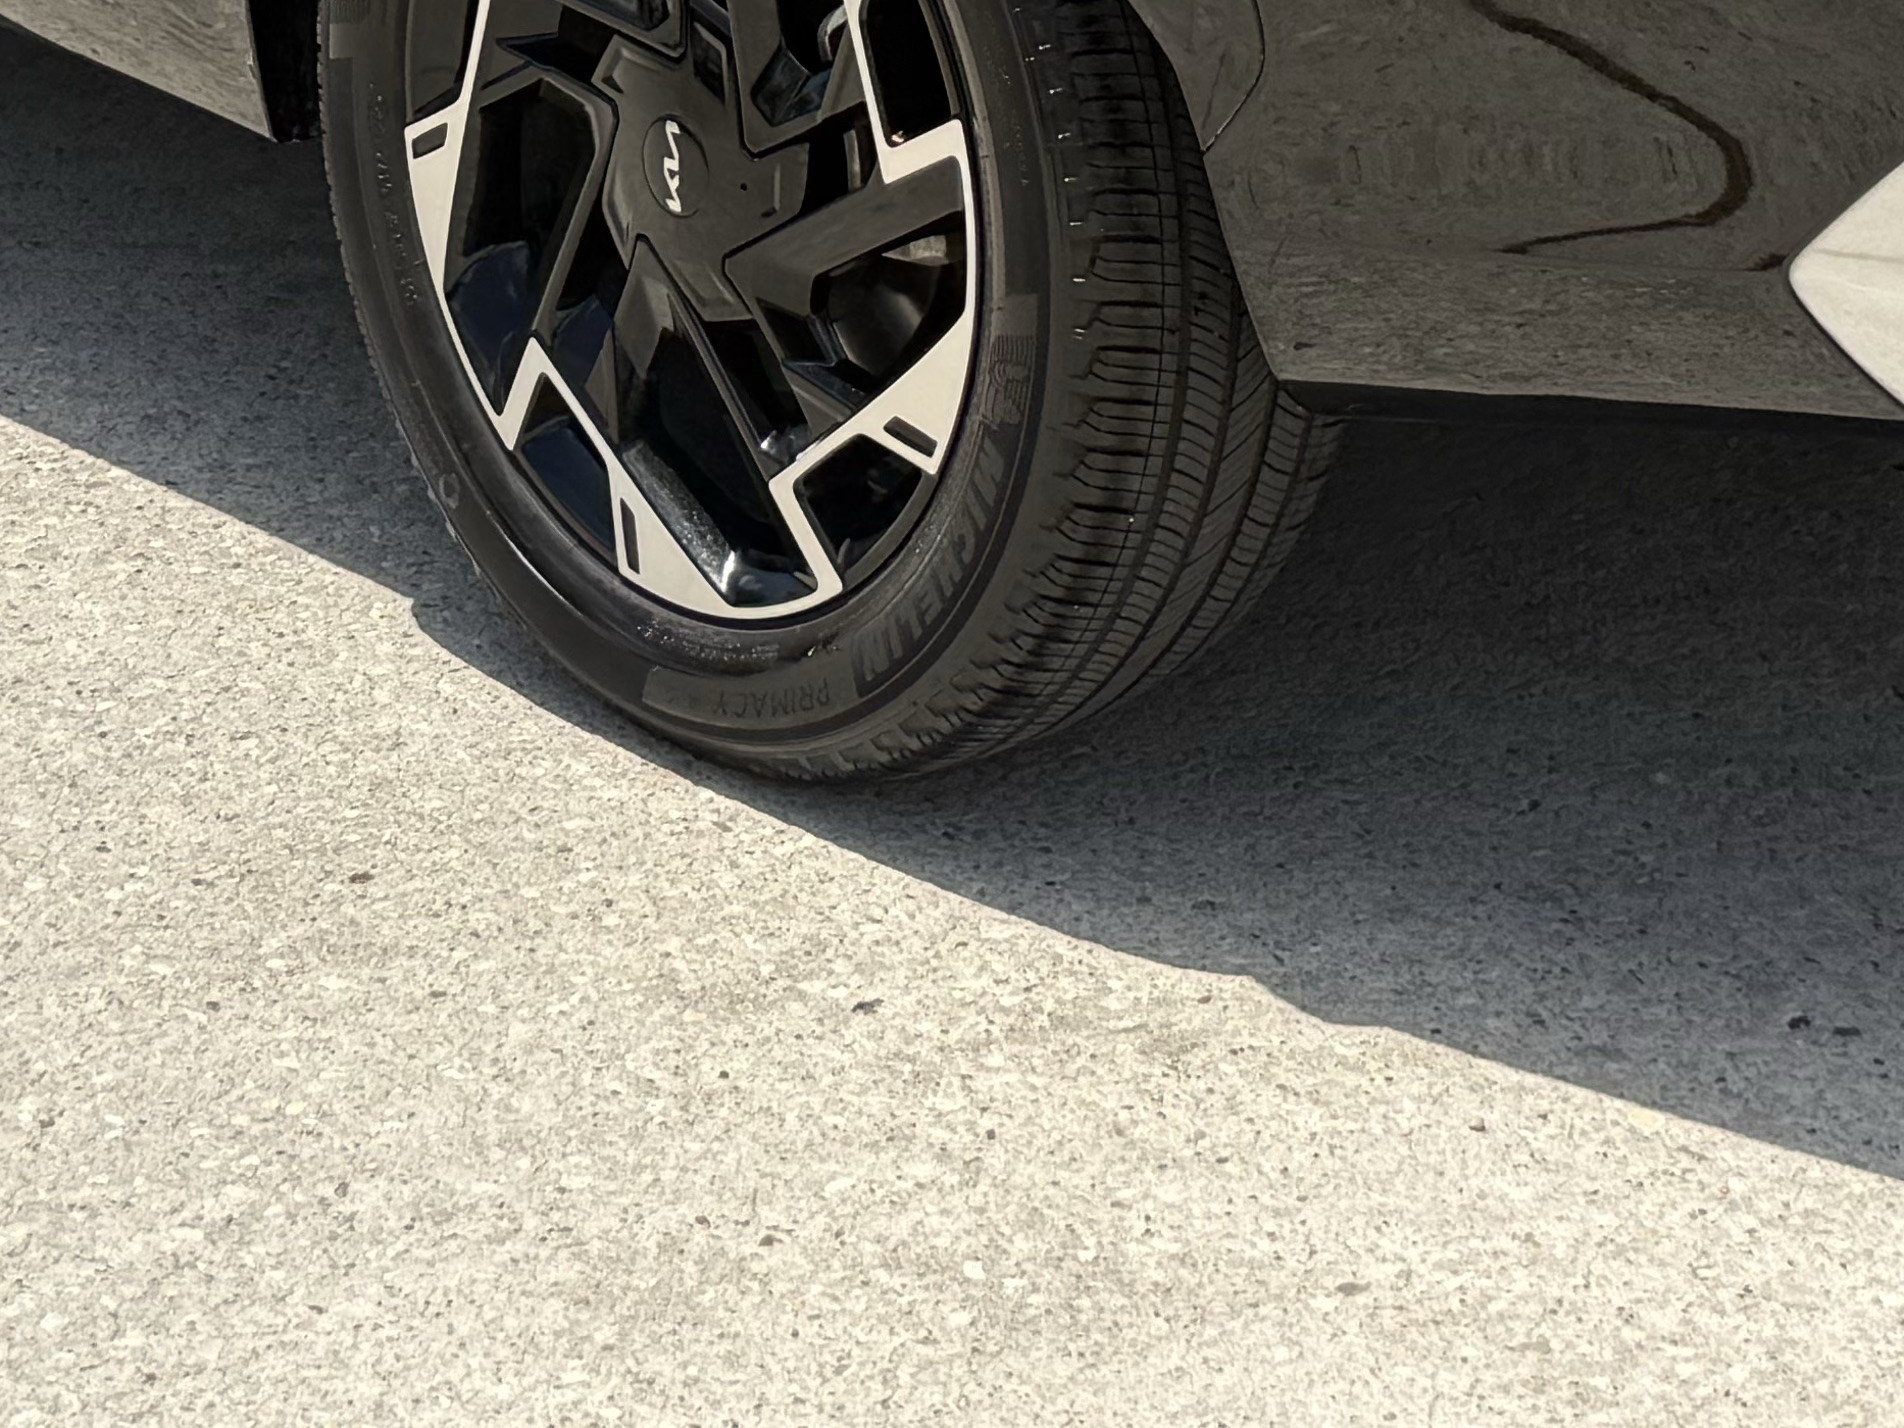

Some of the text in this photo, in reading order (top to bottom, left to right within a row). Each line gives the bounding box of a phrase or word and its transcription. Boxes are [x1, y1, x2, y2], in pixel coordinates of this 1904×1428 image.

[662, 119, 683, 214] KIA
[855, 434, 1005, 681] MICHELIN
[711, 678, 831, 719] PRIMACY
